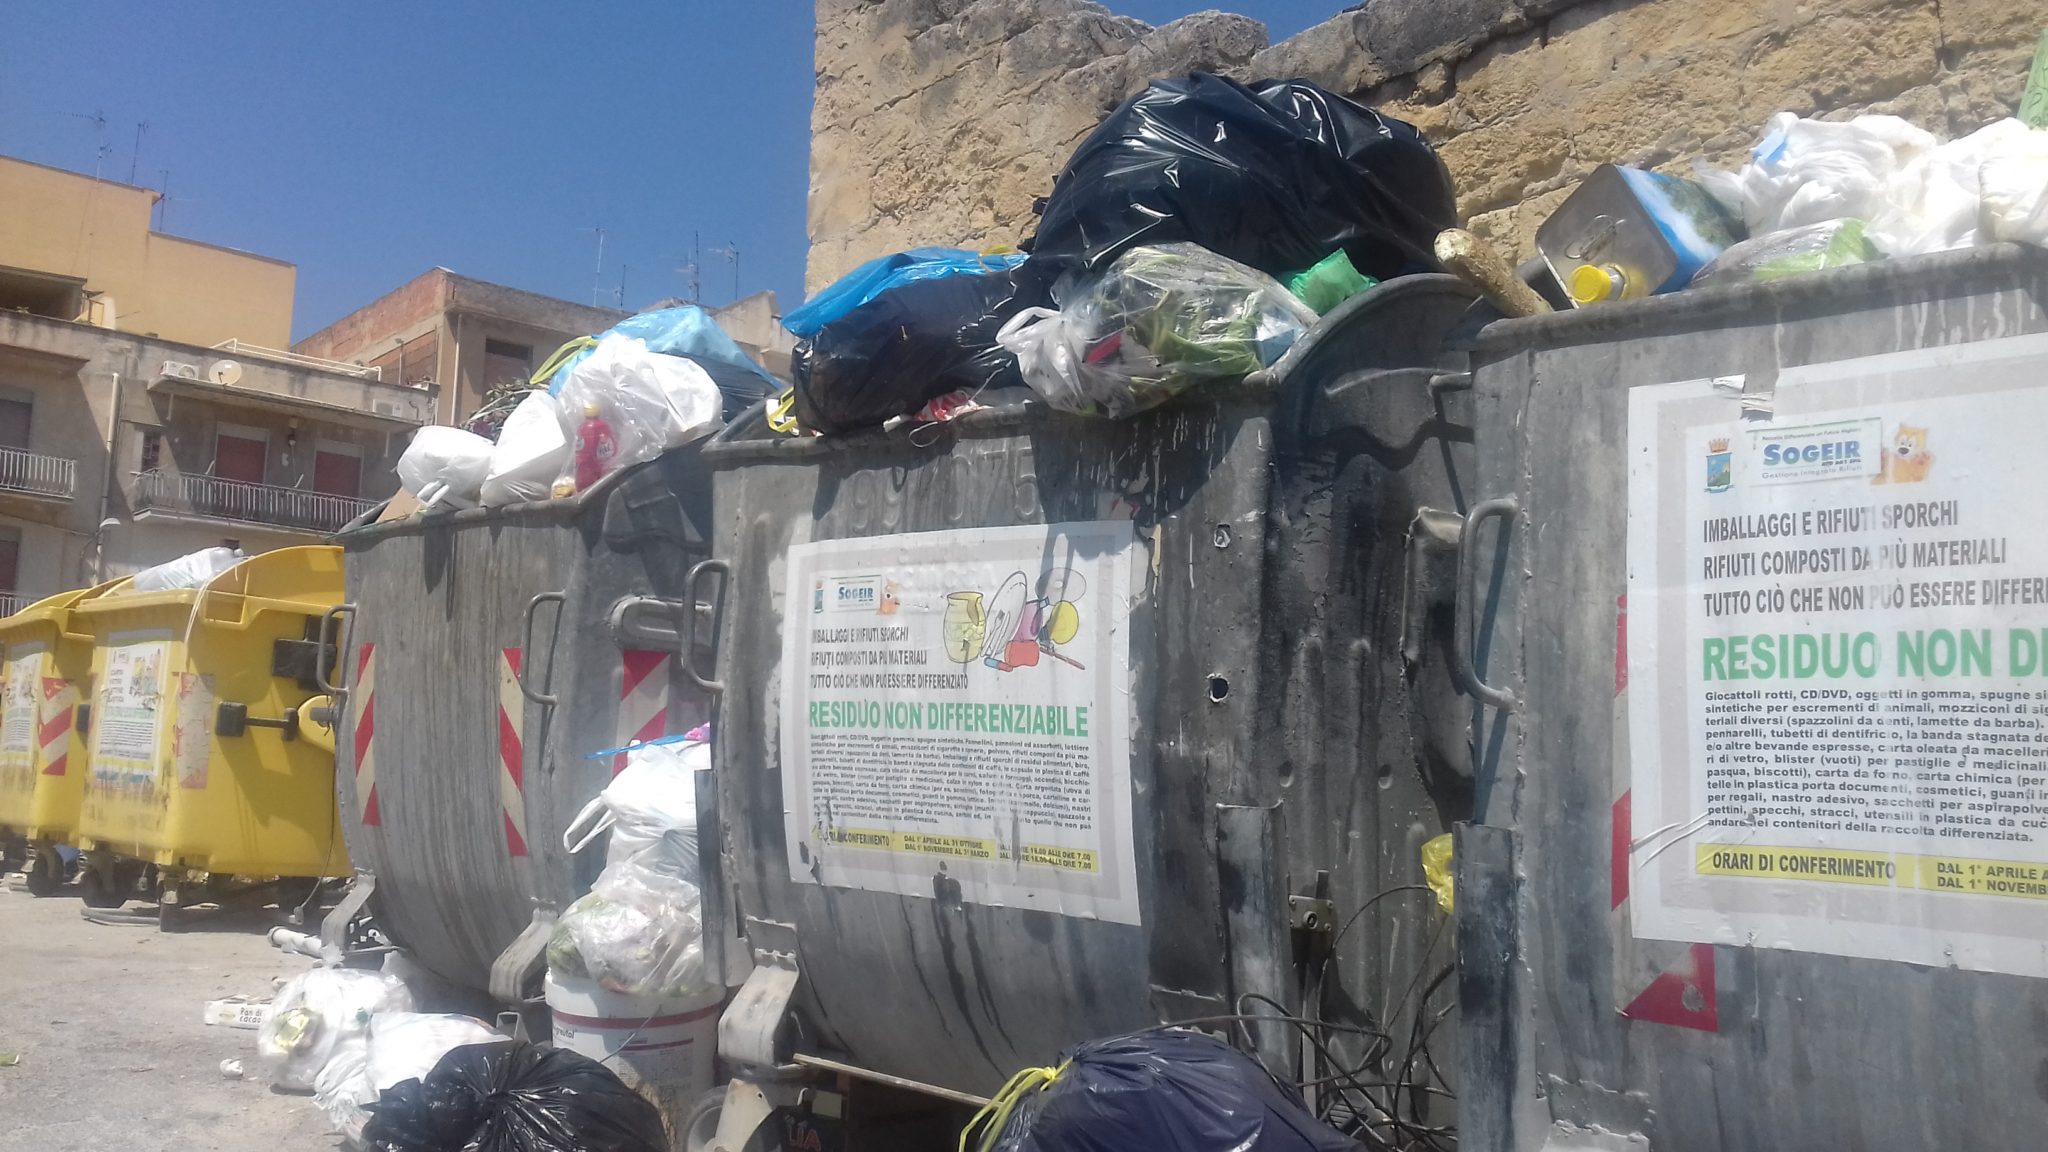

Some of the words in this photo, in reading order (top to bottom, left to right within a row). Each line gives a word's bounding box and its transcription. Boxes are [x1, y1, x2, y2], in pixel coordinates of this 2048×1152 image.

[1703, 512, 1797, 543] IMBALLAGGI
[1802, 511, 1812, 536] E
[1817, 506, 1876, 534] RIFIUTI
[1882, 500, 1958, 529] SPORCHI
[1703, 552, 1756, 580] RIFIUTI
[1760, 547, 1845, 575] COMPOSTI
[1852, 546, 1871, 571] DA
[1879, 537, 1907, 569] PIÙ
[1913, 537, 2006, 568] MATERIALI
[1703, 590, 1751, 617] TUTTO
[1756, 583, 1784, 613] CIÒ
[1790, 587, 1823, 612] CHE
[1828, 585, 1864, 611] NON
[1868, 578, 1904, 610] PUÒ
[1910, 580, 1976, 607] ESSERE
[1982, 577, 2048, 605] DIFFER
[1703, 631, 1880, 681] RESIDUO
[1897, 629, 1992, 677] NON
[860, 674, 874, 689] NON
[1705, 690, 1761, 701] Giocattoli
[1765, 690, 1797, 701] rotti,
[1800, 689, 1852, 700] CD/DVD,
[1906, 690, 1918, 699] in
[1921, 691, 1975, 701] gomma,
[1980, 691, 2031, 702] spugne
[1705, 703, 1763, 713] sintetiche
[1766, 704, 1789, 714] per
[1792, 703, 1864, 713] escrementi
[1868, 703, 1880, 713] di
[1884, 703, 1935, 714] animali,
[1939, 704, 2010, 714] mozziconi
[2014, 704, 2027, 714] di
[809, 700, 881, 728] RESIDUO
[885, 702, 922, 729] NON
[928, 703, 1089, 737] DIFFERENZIABILE
[1705, 716, 1737, 726] teriali
[1740, 715, 1783, 725] diversi
[1787, 716, 1853, 727] (spazzolini
[1857, 716, 1873, 726] da
[1917, 716, 1969, 727] lamette
[1973, 717, 1991, 727] da
[1995, 718, 2045, 730] barba).
[1705, 728, 1767, 740] pennarelli,
[1770, 729, 1813, 738] tubetti
[1817, 729, 1829, 738] di
[1906, 730, 1918, 739] la
[1921, 730, 1962, 740] banda
[1967, 732, 2030, 744] stagnata
[1706, 742, 1722, 751] e/o
[1725, 741, 1751, 751] altre
[1755, 741, 1809, 751] bevande
[1812, 743, 1874, 753] espresse,
[1916, 744, 1958, 754] oleata
[1962, 745, 1979, 755] da
[1706, 754, 1714, 764] ri
[1719, 754, 1729, 764] di
[1733, 755, 1769, 765] vetro,
[1774, 754, 1815, 764] blister
[1820, 755, 1862, 767] (vuoti)
[1867, 757, 1888, 768] per
[1895, 757, 1951, 770] pastiglie
[1707, 768, 1751, 779] pasqua,
[1754, 767, 1811, 779] biscotti),
[1815, 768, 1849, 778] carta
[1853, 769, 1870, 779] da
[1916, 772, 1951, 782] carta
[1955, 773, 2012, 785] chimica
[2017, 775, 2046, 787] (per
[1707, 779, 1732, 789] telle
[1734, 779, 1744, 789] in
[1747, 780, 1799, 791] plastica
[1802, 782, 1835, 792] porta
[1838, 781, 1912, 795] documenti,
[1916, 785, 1987, 799] cosmetici,
[1707, 794, 1726, 803] per
[1729, 793, 1767, 803] regali,
[1772, 794, 1812, 803] nastro
[1816, 795, 1869, 806] adesivo,
[1874, 797, 1935, 809] sacchetti
[1939, 800, 1963, 811] per
[1707, 805, 1747, 816] pettini,
[1751, 806, 1805, 818] specchi,
[1810, 808, 1858, 819] stracci,
[1864, 810, 1913, 821] utensili
[1919, 812, 1930, 822] in
[1935, 812, 1992, 826] plastica
[1998, 816, 2015, 827] da
[1772, 819, 1841, 831] contenitori
[1845, 821, 1877, 832] della
[1881, 824, 1935, 836] raccolta
[1939, 827, 2033, 842] differenziata.
[1713, 851, 1753, 872] ORARI
[1758, 853, 1774, 872] DI
[1780, 854, 1896, 880] CONFERIMENTO
[1937, 862, 1964, 876] DAL
[1986, 866, 2037, 881] APRILE
[1937, 876, 1964, 889] DAL
[239, 1016, 262, 1024] cacao
